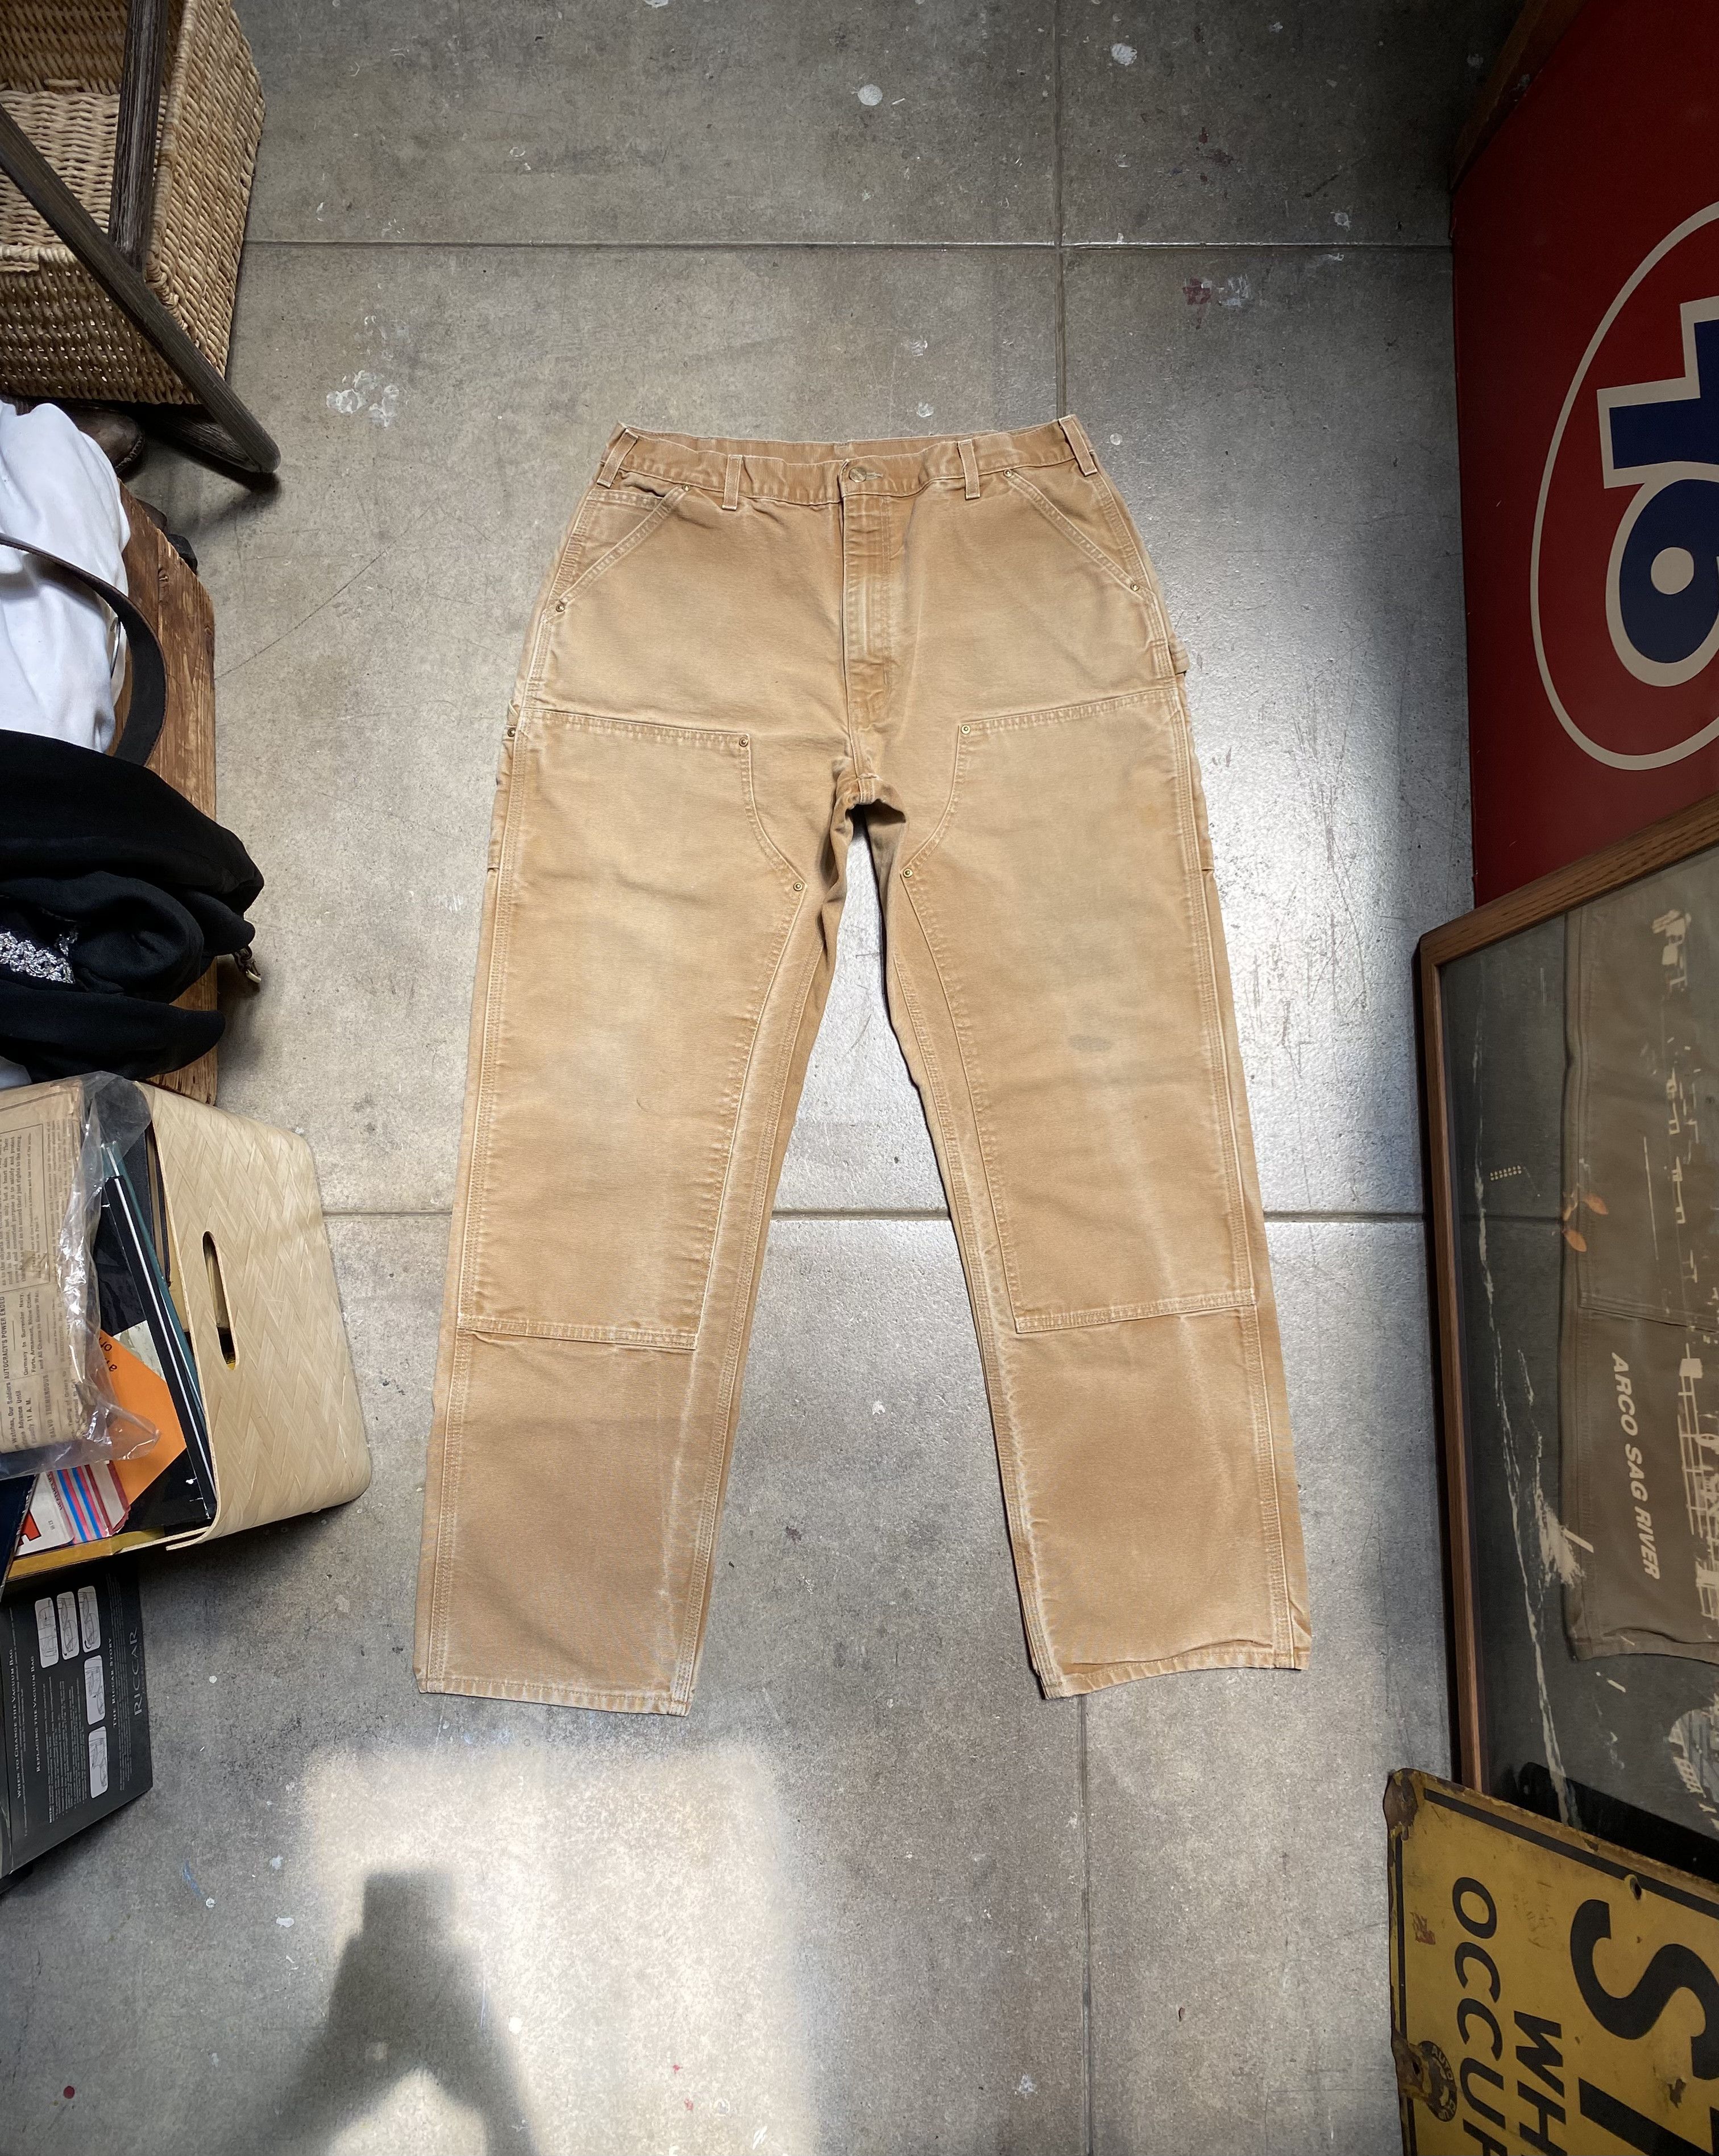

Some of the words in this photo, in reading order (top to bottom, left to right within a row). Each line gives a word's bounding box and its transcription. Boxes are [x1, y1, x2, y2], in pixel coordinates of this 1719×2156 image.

[1611, 1352, 1638, 1436] ARCO
[1625, 1444, 1649, 1502] SAG
[1634, 1506, 1660, 1580] RIVER
[129, 1627, 143, 1715] RICCAR
